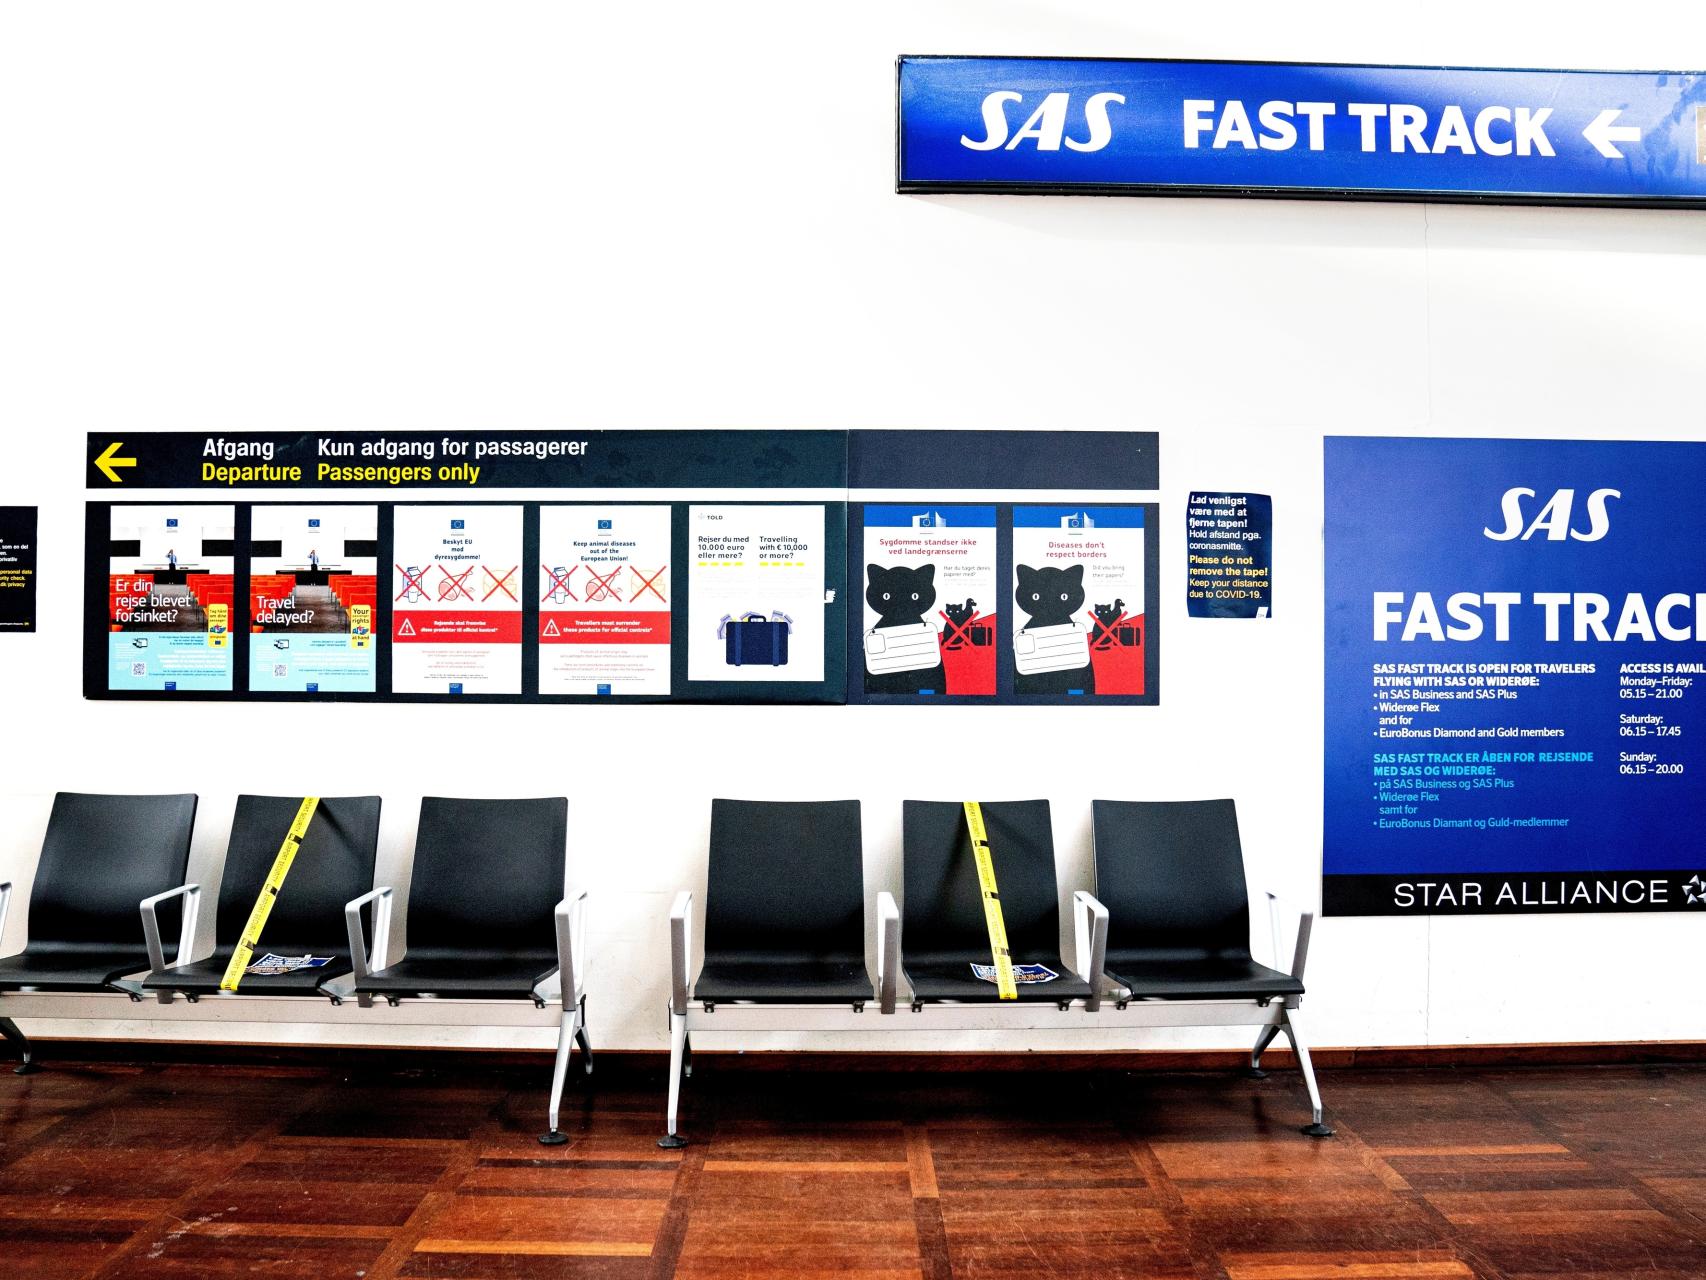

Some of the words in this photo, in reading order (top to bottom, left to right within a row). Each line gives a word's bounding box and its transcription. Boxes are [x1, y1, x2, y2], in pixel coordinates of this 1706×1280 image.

[960, 91, 1126, 152] SAS
[1184, 100, 1336, 151] FAST
[1348, 103, 1556, 157] TRACK
[203, 438, 274, 460] Afgang
[318, 439, 354, 456] Kun
[361, 438, 434, 460] adgang
[442, 438, 469, 455] for
[476, 442, 588, 459] passagerer
[203, 463, 301, 484] Departure
[318, 464, 431, 484] Passengers
[439, 463, 480, 484] only
[1191, 496, 1206, 504] Lad
[1209, 496, 1246, 506] venligst
[1214, 508, 1234, 516] med
[1484, 487, 1621, 541] SAS
[1189, 518, 1215, 528] fjerne
[1217, 519, 1247, 529] tapen!
[1190, 530, 1207, 538] Hold
[1209, 530, 1240, 538] afstand
[1190, 555, 1219, 564] Please
[1222, 556, 1234, 564] do
[1226, 567, 1241, 576] the
[1243, 568, 1268, 577] tape!
[116, 580, 129, 591] Er
[133, 579, 153, 591] din
[1190, 578, 1210, 588] Keep
[1216, 590, 1262, 598] COVID-19.
[116, 595, 146, 609] rejse
[151, 594, 191, 606] blevet
[257, 596, 295, 608] Travel
[116, 609, 178, 622] forsinket?
[257, 610, 314, 625] delayed?
[1374, 592, 1521, 641] FAST
[1373, 664, 1396, 673] SAS
[1398, 664, 1425, 673] FAST
[1427, 664, 1464, 673] TRACK
[1466, 664, 1477, 673] IS
[1478, 664, 1508, 673] OPEN
[1511, 664, 1532, 673] FOR
[1534, 664, 1595, 673] TRAVELERS
[1620, 664, 1661, 673] ACCESS
[1663, 664, 1674, 673] IS
[1374, 677, 1411, 686] FLYING
[1413, 676, 1442, 686] WITH
[1444, 677, 1466, 686] SAS
[1468, 676, 1484, 686] OR
[1486, 676, 1539, 686] WIDERØE:
[1620, 676, 1692, 688] Monday–Friday:
[1380, 690, 1388, 699] in
[1390, 690, 1410, 699] SAS
[1412, 690, 1454, 699] Business
[1456, 690, 1474, 699] and
[1476, 690, 1495, 698] SAS
[1498, 689, 1517, 698] Plus
[1620, 689, 1646, 698] 05.15
[1656, 689, 1682, 698] 21.00
[1379, 702, 1419, 712] Widerøe
[1421, 702, 1439, 712] Flex
[1380, 715, 1397, 724] and
[1399, 715, 1413, 724] for
[1620, 714, 1663, 725] Saturday:
[1380, 728, 1431, 738] EuroBonus
[1434, 728, 1475, 737] Diamond
[1478, 728, 1495, 737] and
[1497, 728, 1518, 737] Gold
[1521, 728, 1564, 736] members
[1620, 726, 1646, 736] 06.15
[1657, 726, 1681, 736] 17.45
[1374, 754, 1396, 763] SAS
[1398, 754, 1425, 763] FAST
[1427, 753, 1463, 762] TRACK
[1466, 753, 1479, 762] ER
[1482, 751, 1511, 762] ÅBEN
[1514, 753, 1534, 762] FOR
[1539, 752, 1593, 762] REJSENDE
[1620, 752, 1656, 763] Sunday:
[1374, 766, 1398, 776] MED
[1400, 766, 1422, 776] SAS
[1424, 766, 1440, 775] OG
[1442, 766, 1495, 775] WIDERØE:
[1620, 764, 1646, 774] 06.15
[1656, 764, 1683, 774] 20.00
[1380, 779, 1391, 790] på
[1393, 779, 1413, 788] SAS
[1416, 779, 1457, 788] Business
[1459, 781, 1470, 790] og
[1473, 778, 1492, 788] SAS
[1495, 778, 1514, 787] Plus
[1379, 792, 1418, 801] Widerøe
[1421, 792, 1439, 801] Flex
[1380, 806, 1402, 814] samt
[1404, 805, 1418, 814] for
[1380, 818, 1431, 828] EuroBonus
[1434, 818, 1472, 827] Diamant
[1474, 820, 1486, 829] og
[1488, 818, 1568, 826] Guld-medlemmer
[1394, 883, 1481, 906] STAR
[1496, 880, 1668, 905] ALLIANCE
